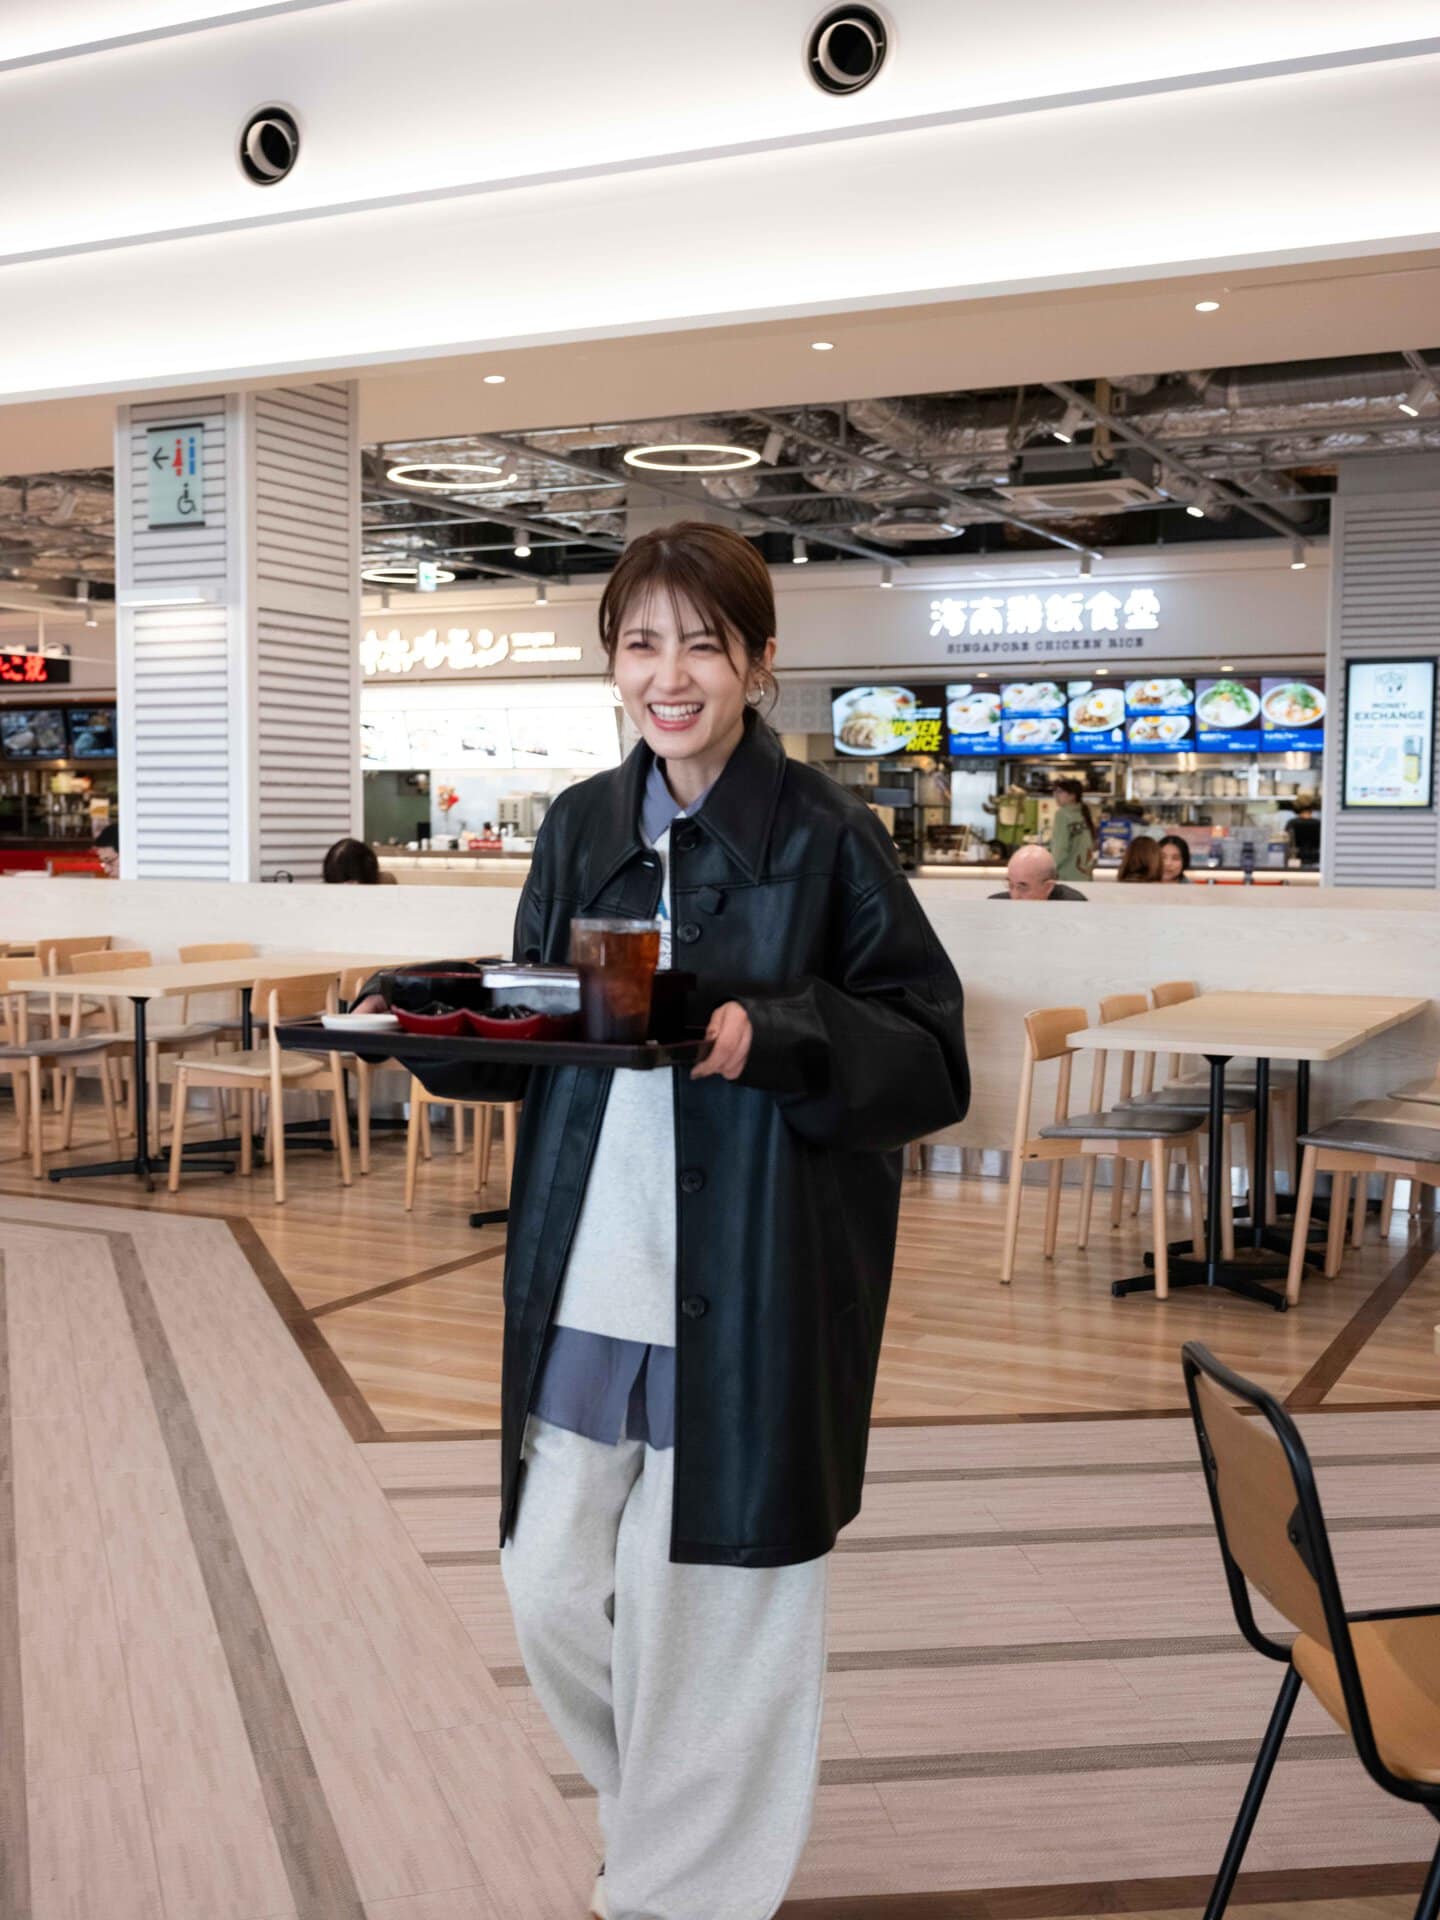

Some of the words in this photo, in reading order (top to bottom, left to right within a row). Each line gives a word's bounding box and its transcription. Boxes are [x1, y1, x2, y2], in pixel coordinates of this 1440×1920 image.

[947, 641, 1029, 654] SINGAPORE
[1035, 638, 1103, 651] CHICKEN
[1108, 636, 1145, 649] RICE
[1354, 711, 1425, 721] EXCHANGE
[906, 735, 942, 751] RICE
